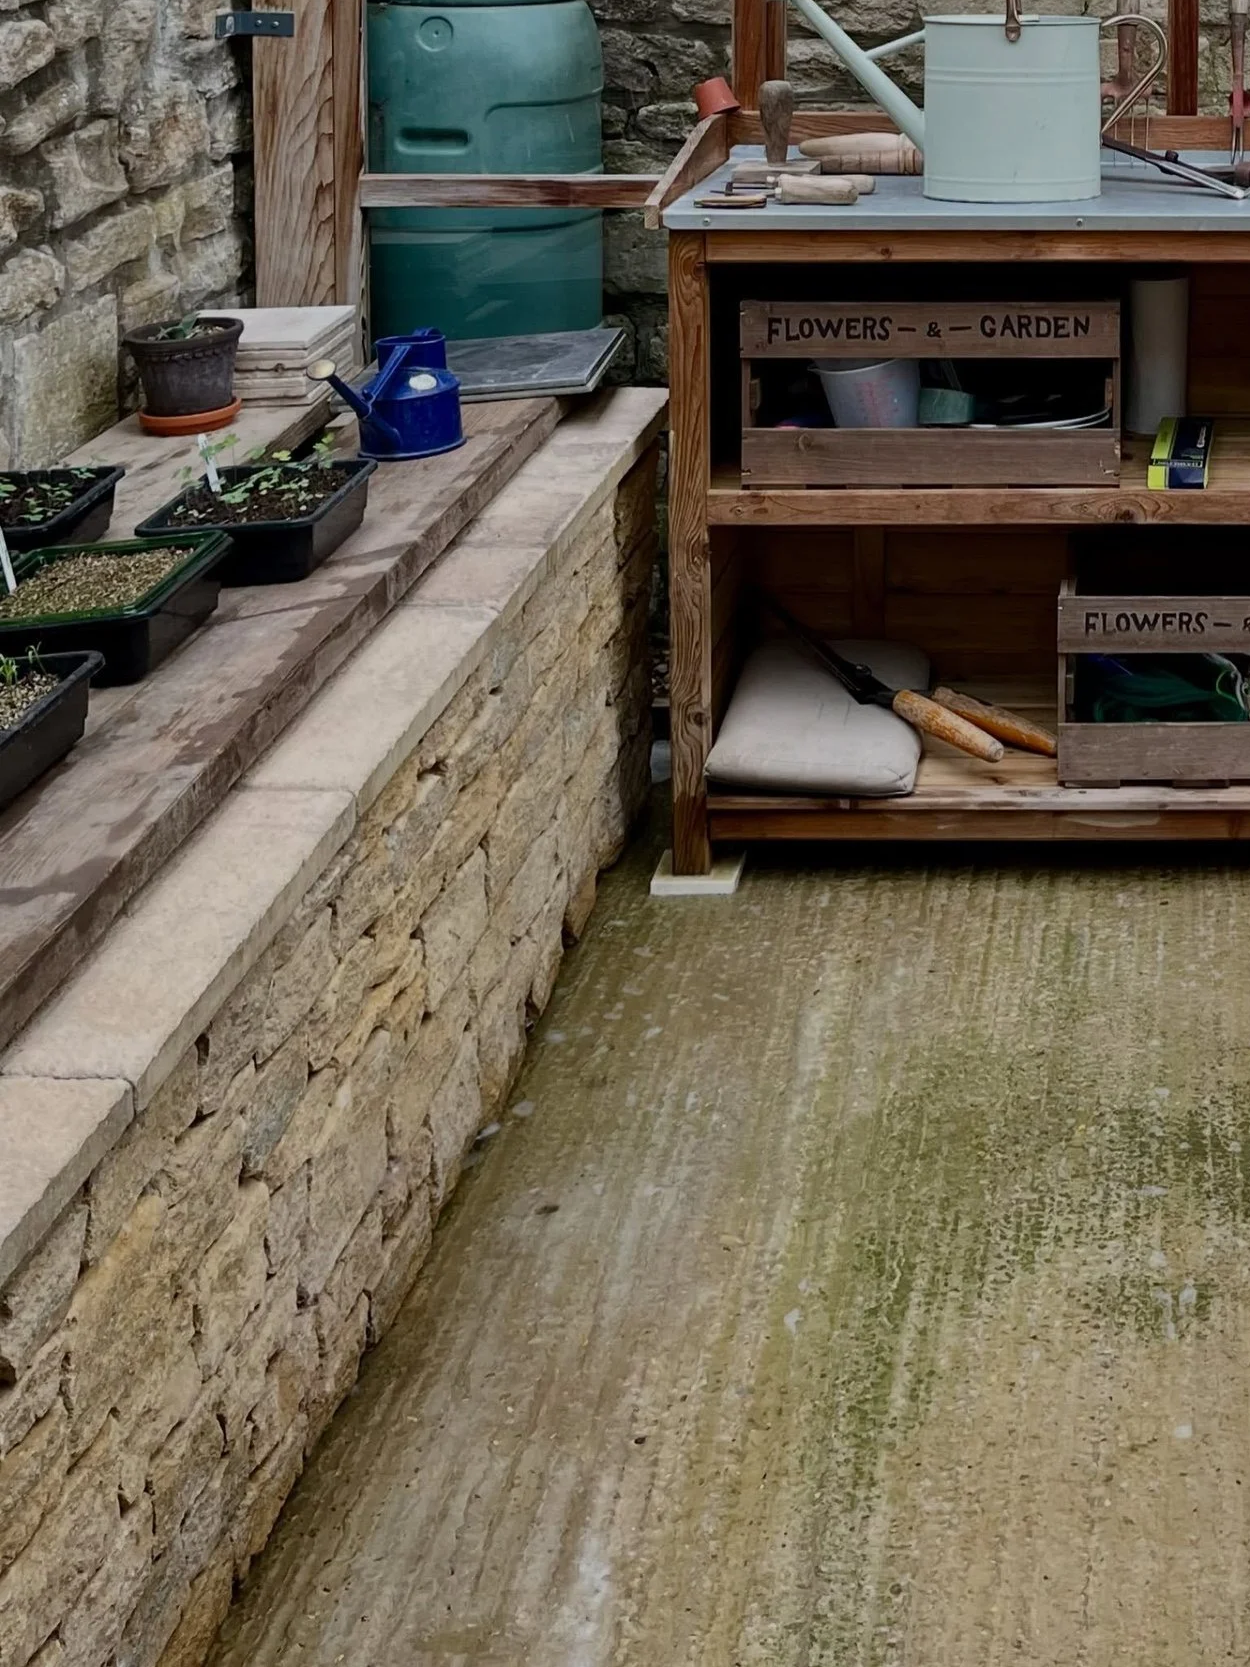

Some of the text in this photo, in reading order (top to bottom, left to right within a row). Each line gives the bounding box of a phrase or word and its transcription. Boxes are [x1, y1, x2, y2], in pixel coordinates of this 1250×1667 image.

[766, 315, 893, 345] FLOWERS
[979, 314, 1091, 339] GARDEN
[1084, 611, 1209, 635] FLOWERS
